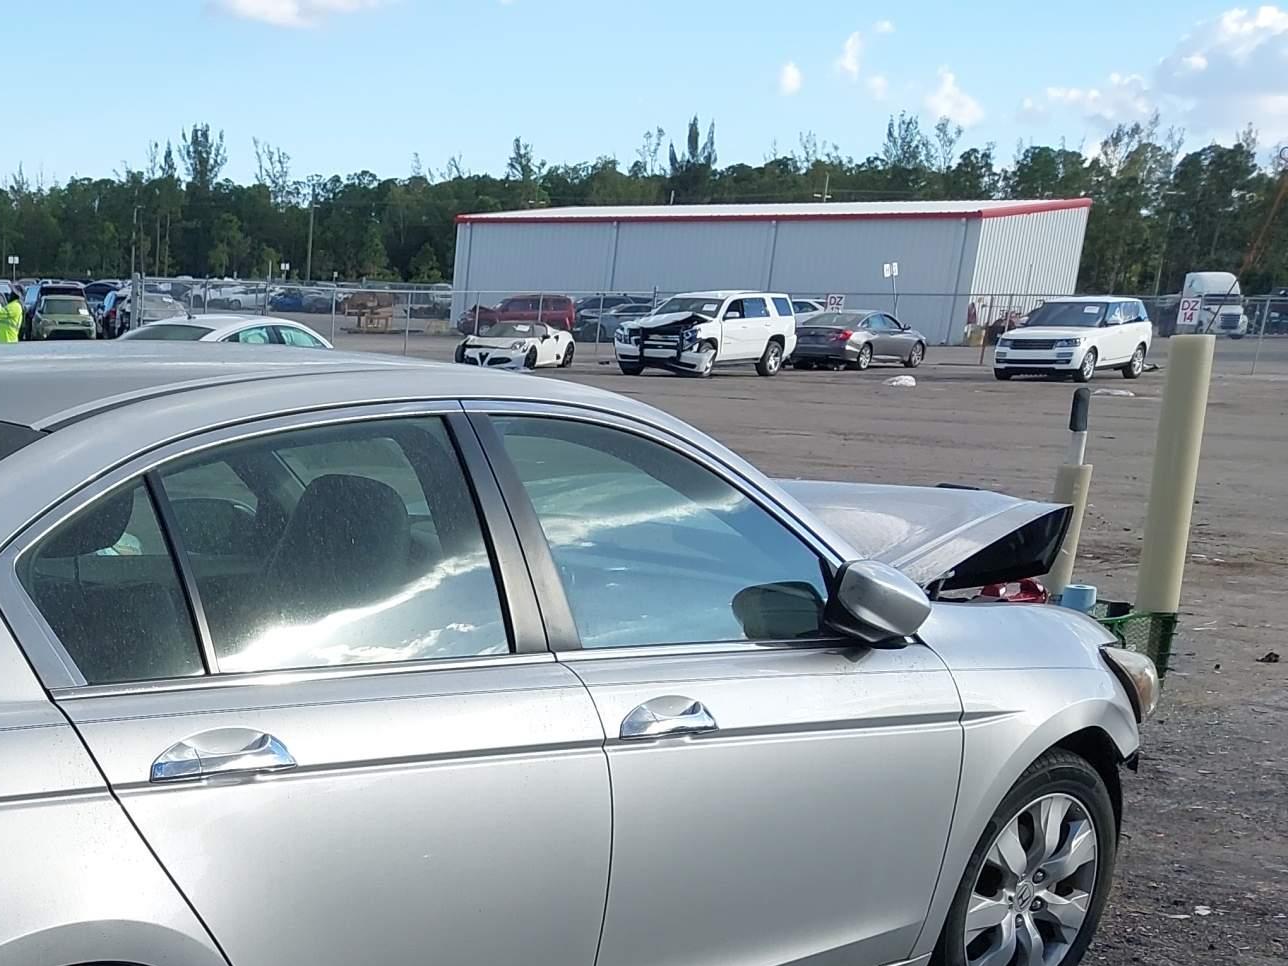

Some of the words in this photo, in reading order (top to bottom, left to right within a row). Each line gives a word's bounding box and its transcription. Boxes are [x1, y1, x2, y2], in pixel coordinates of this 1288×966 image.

[829, 295, 843, 305] DZ
[1182, 300, 1199, 311] DZ
[1184, 311, 1194, 322] 14
